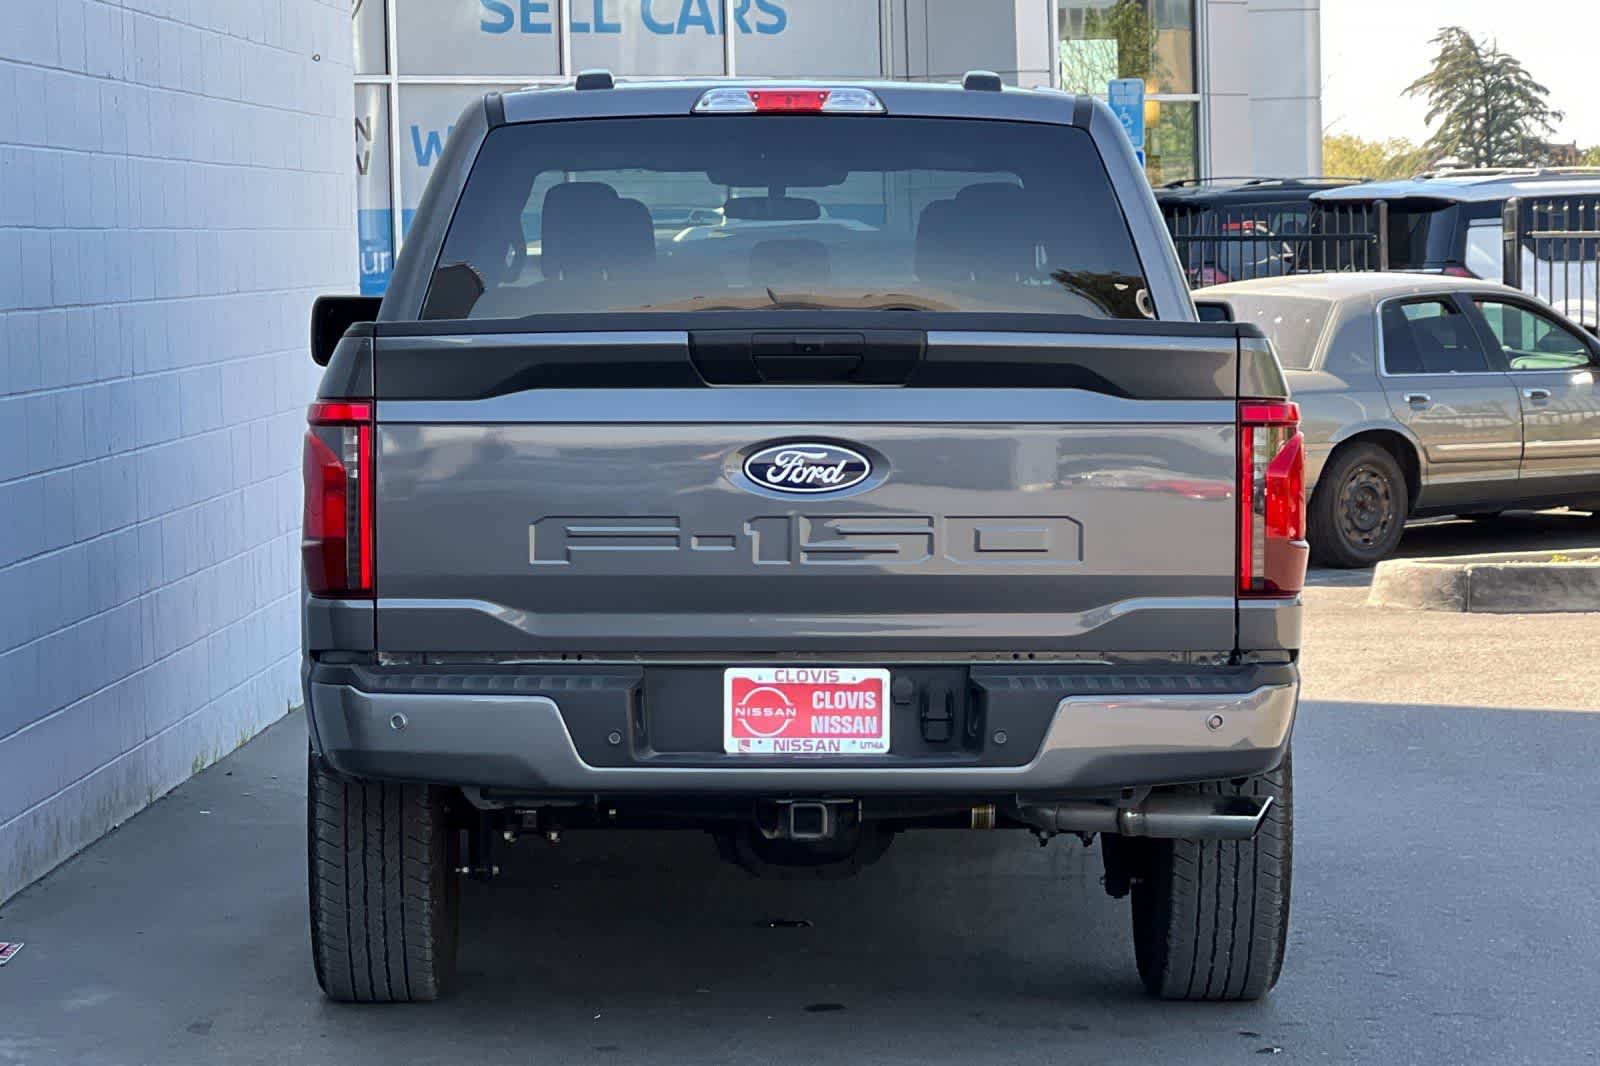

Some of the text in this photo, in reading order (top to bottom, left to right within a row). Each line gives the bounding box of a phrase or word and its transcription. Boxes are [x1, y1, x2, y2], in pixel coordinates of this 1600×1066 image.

[480, 0, 787, 35] SELL CARS
[766, 450, 848, 484] Ford
[529, 515, 1083, 565] F-150
[774, 669, 841, 683] CLOVIS
[811, 690, 877, 710] CLOVIS
[735, 706, 797, 717] NISSAN
[810, 715, 878, 735] NISSAN
[772, 739, 841, 752] NISSAN
